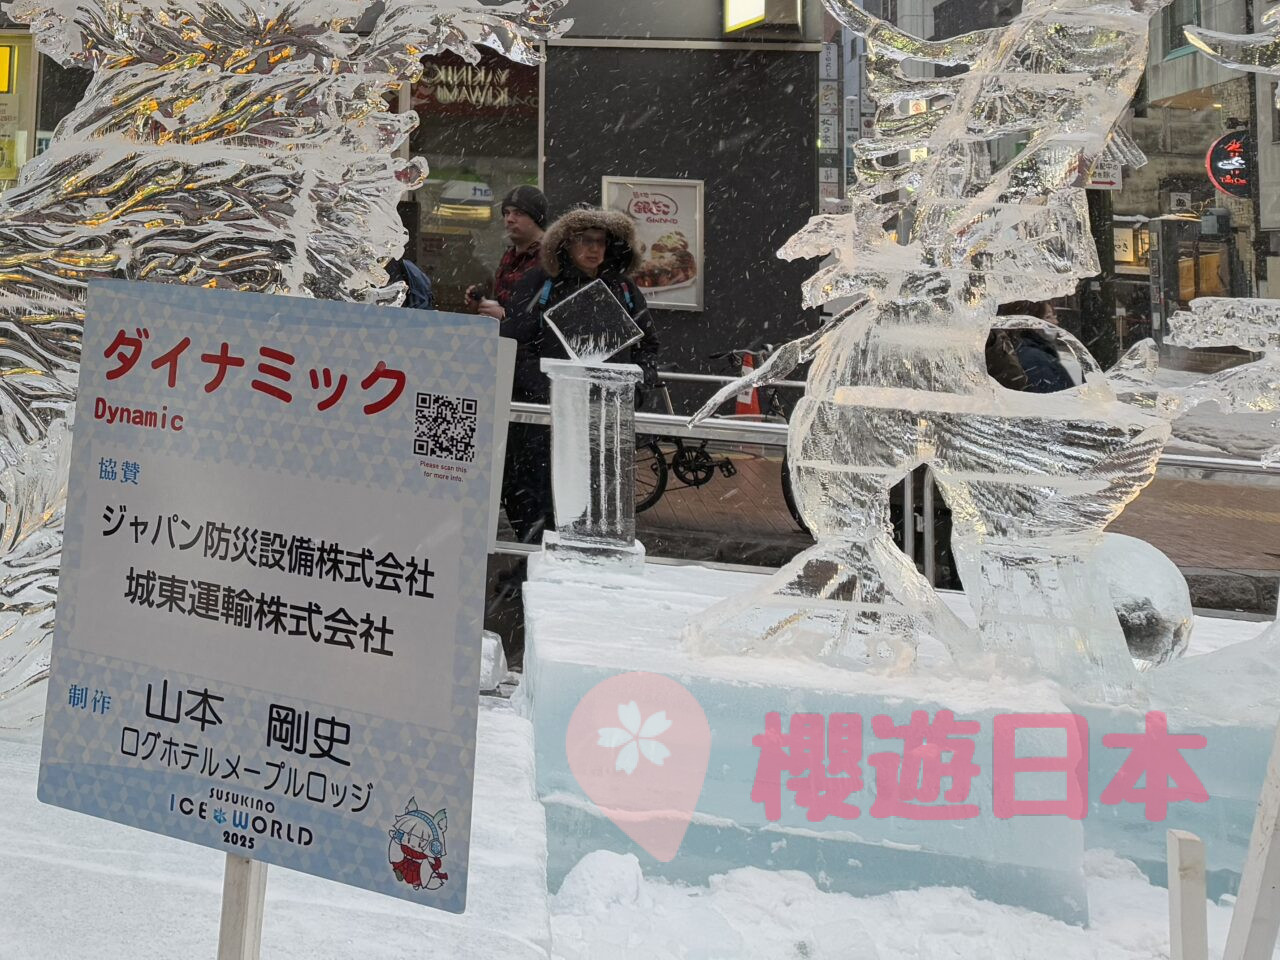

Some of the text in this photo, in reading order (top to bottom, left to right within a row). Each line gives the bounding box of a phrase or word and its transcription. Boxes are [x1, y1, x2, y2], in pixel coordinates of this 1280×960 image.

[103, 328, 407, 416] ダイナミック
[94, 397, 184, 432] Dynamic
[98, 457, 141, 486] 協賛
[420, 460, 440, 470] Please
[455, 466, 468, 474] this
[101, 504, 436, 600] ジャパン防災設備株式会社
[124, 566, 395, 657] 城東運輸株式会社
[68, 679, 352, 767] 制作 山本 剛史
[120, 726, 374, 813] ログホテルメープルロッジ
[170, 793, 314, 847] ICE WORLD
[208, 787, 276, 814] SUSUKINO
[222, 830, 256, 850] 2025
